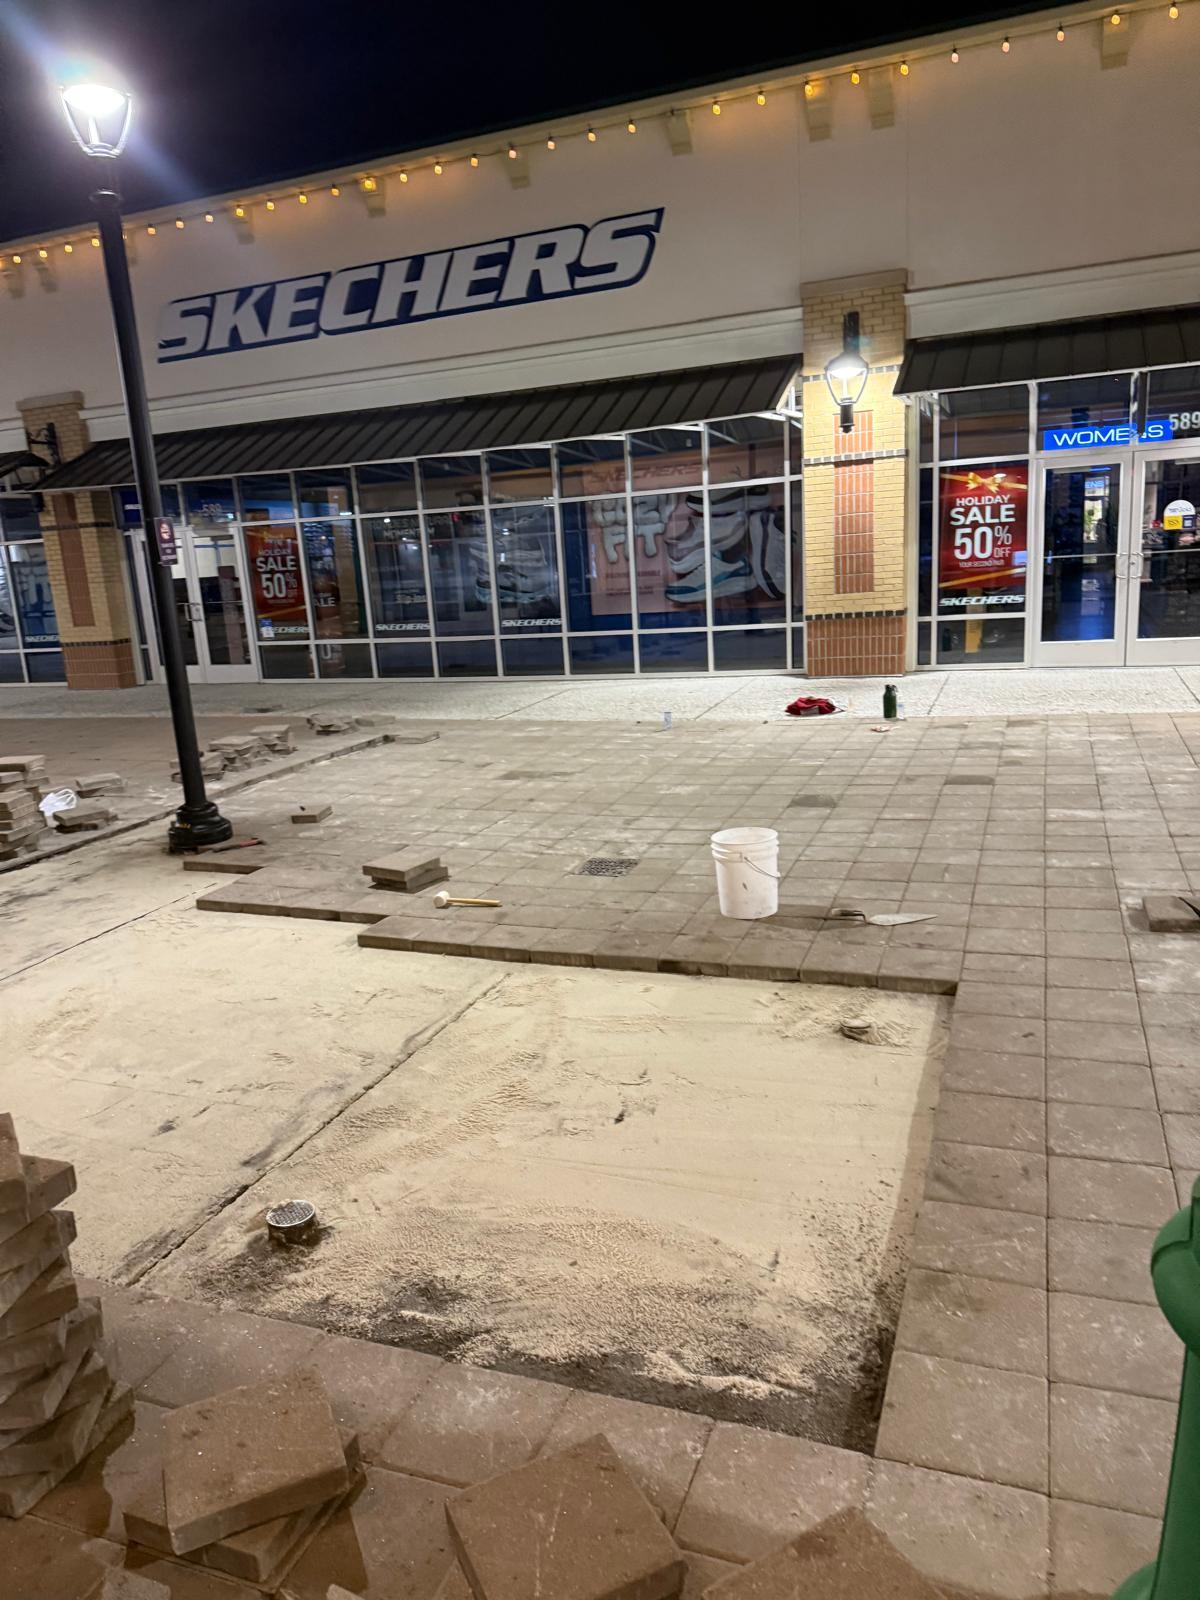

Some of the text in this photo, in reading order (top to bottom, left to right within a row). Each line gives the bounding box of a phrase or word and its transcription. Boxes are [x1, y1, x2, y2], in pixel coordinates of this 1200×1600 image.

[158, 207, 665, 363] SKECHERS
[1053, 424, 1164, 446] WOMES
[956, 495, 1010, 506] HOLIDAY
[950, 504, 1016, 525] SALE
[993, 547, 1011, 558] OFF
[256, 556, 297, 571] SALE
[939, 595, 1024, 607] SKECHERS
[375, 623, 430, 631] SKECHERS
[502, 618, 563, 627] SKECHERS
